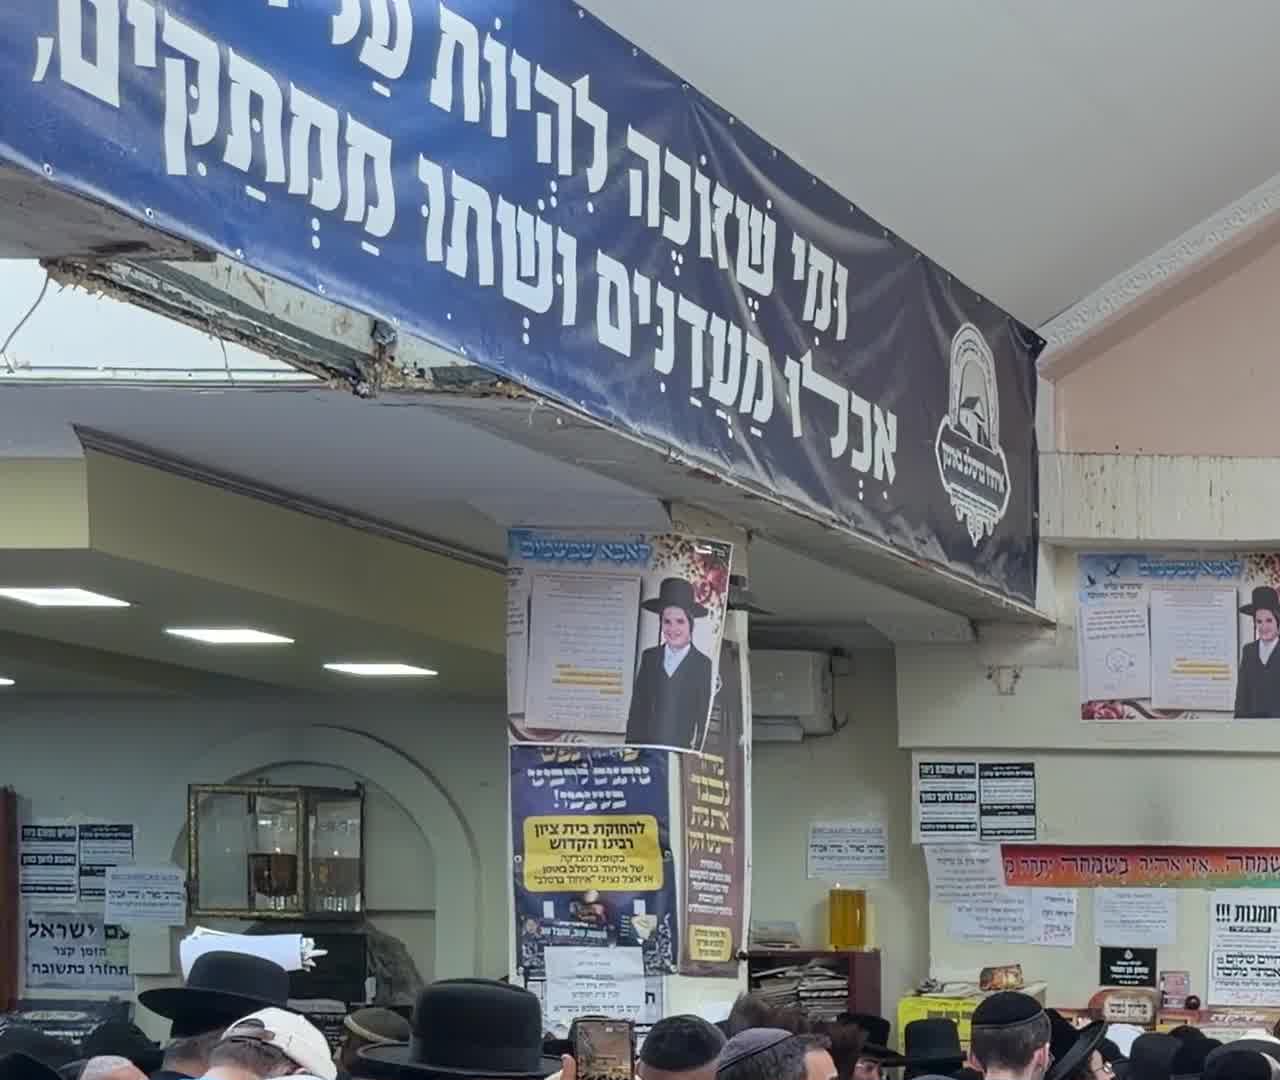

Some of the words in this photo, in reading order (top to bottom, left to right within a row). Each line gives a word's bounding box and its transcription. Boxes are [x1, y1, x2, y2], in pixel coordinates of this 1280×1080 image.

[534, 822, 564, 839] ציון
[565, 822, 589, 836] בית
[28, 917, 96, 941] ישראל
